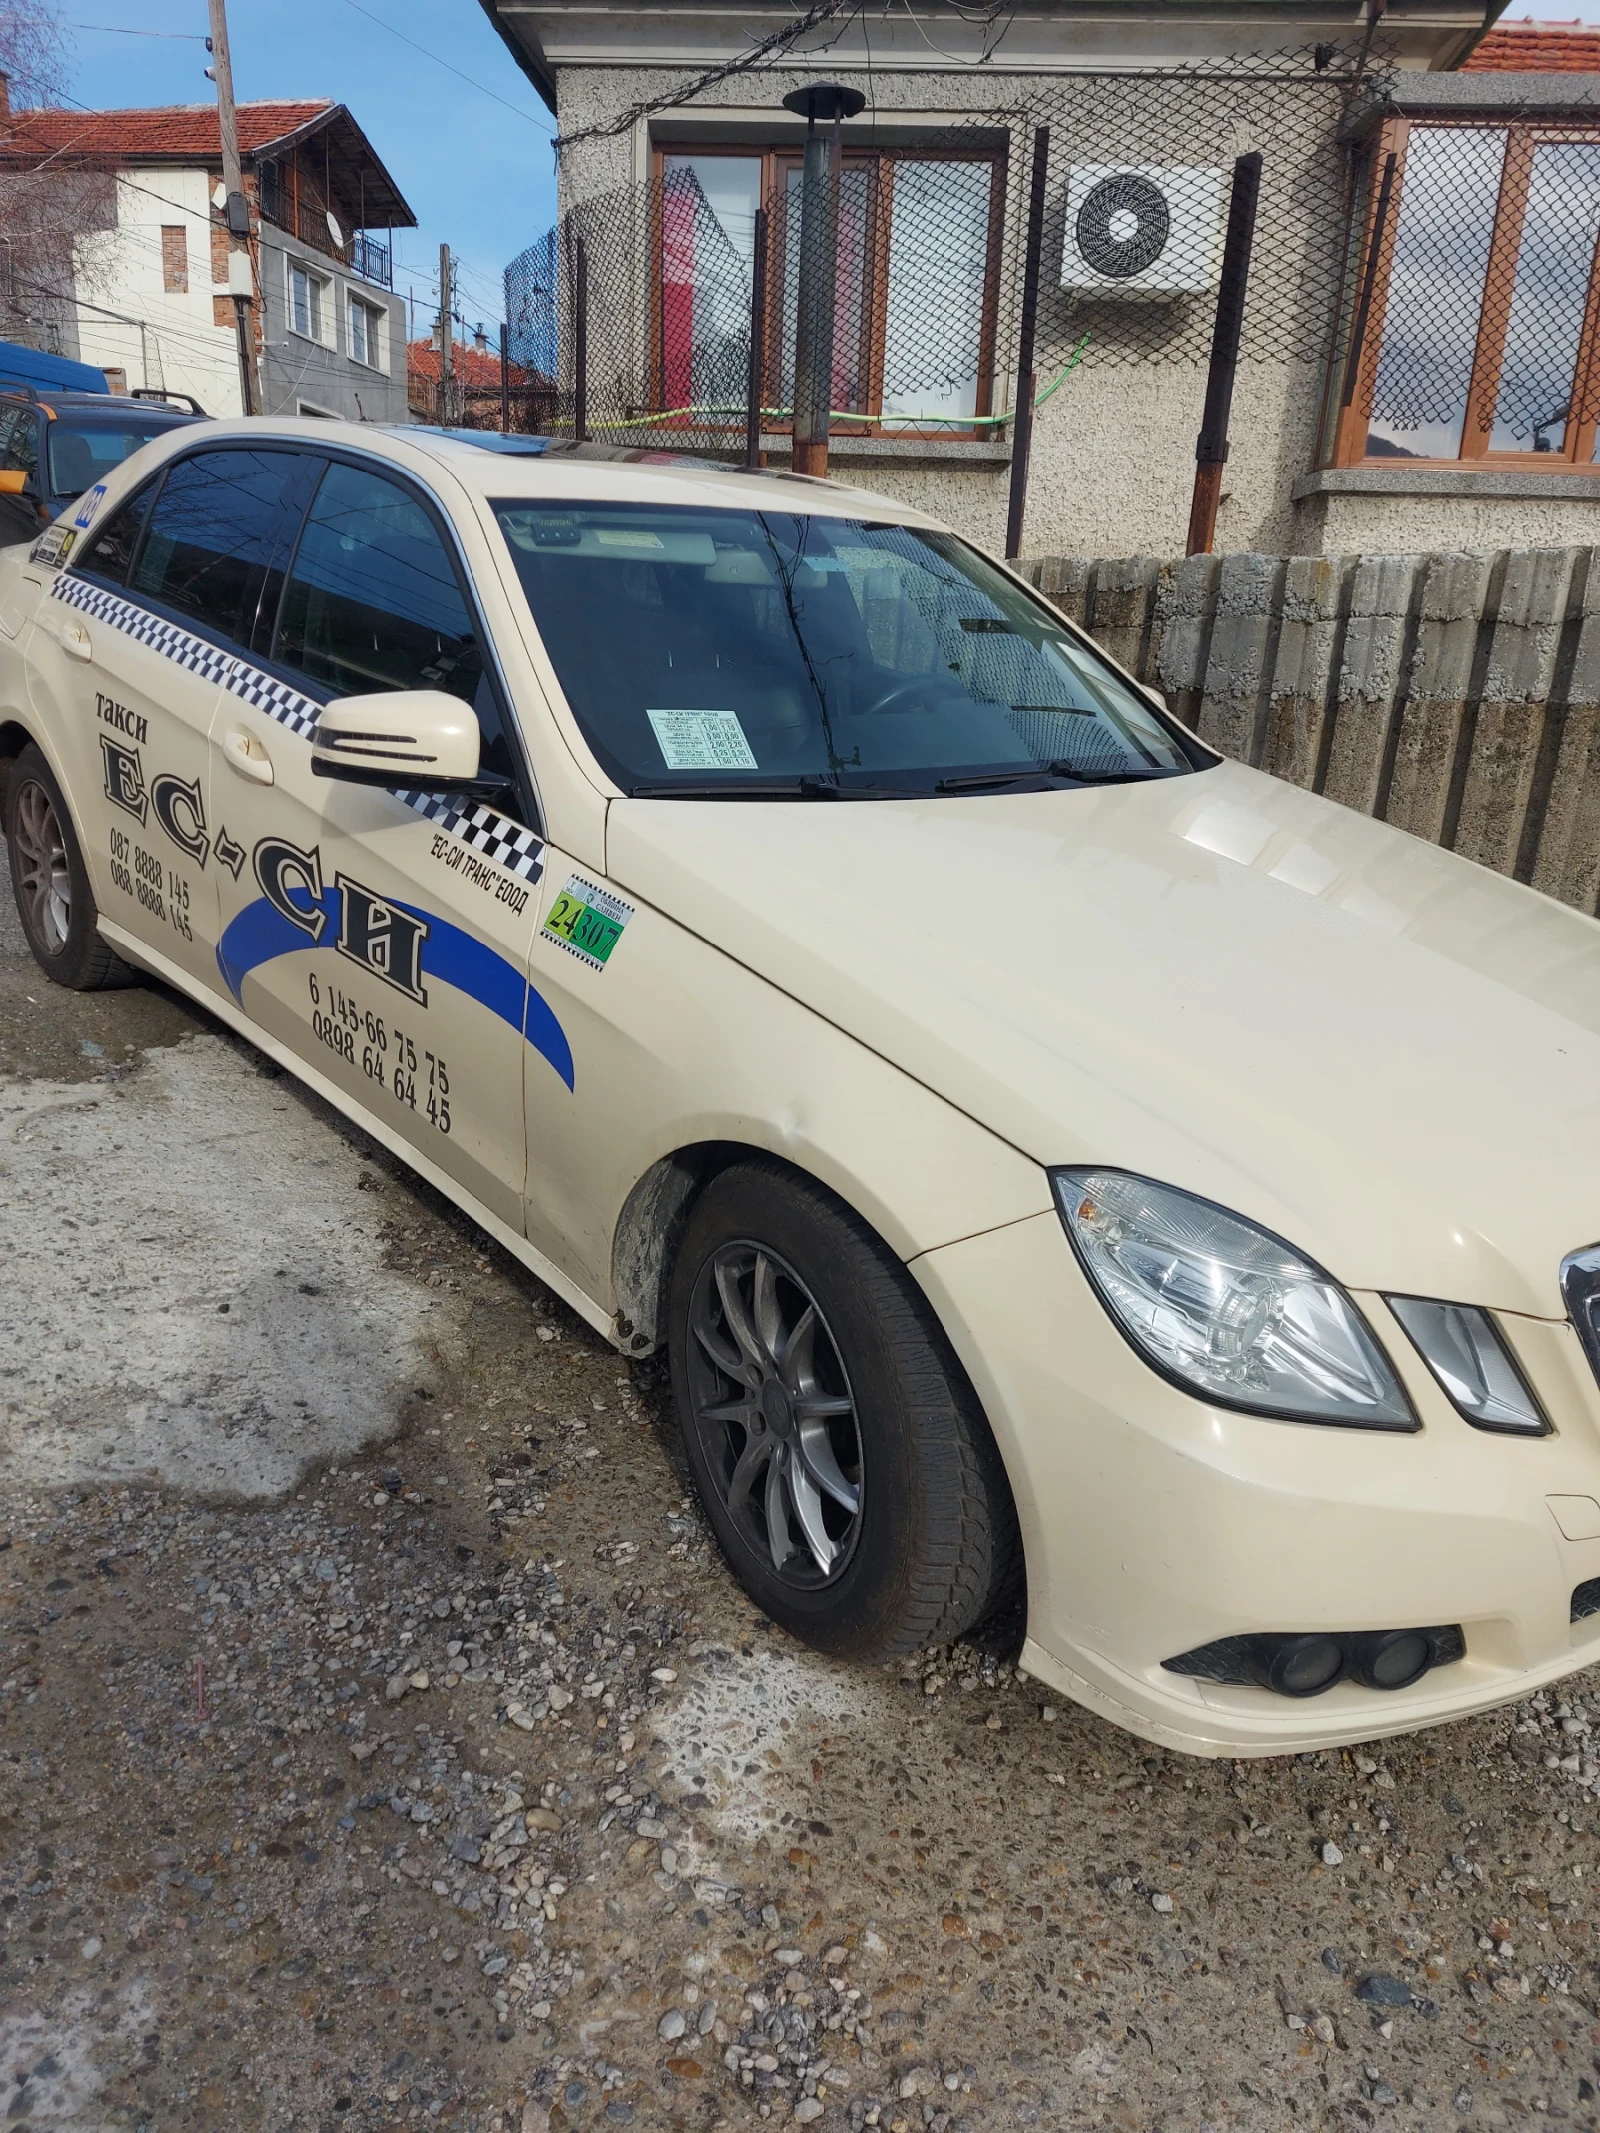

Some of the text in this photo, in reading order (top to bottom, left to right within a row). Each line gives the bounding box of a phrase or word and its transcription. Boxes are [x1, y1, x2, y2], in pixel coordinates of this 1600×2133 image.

[110, 827, 190, 910] 087 8888 145
[110, 858, 193, 943] 088 8888 145
[309, 972, 320, 1005] 6
[394, 1029, 418, 1073] 75
[425, 1050, 450, 1095] 75
[312, 1009, 451, 1134] 0898 64 64 45
